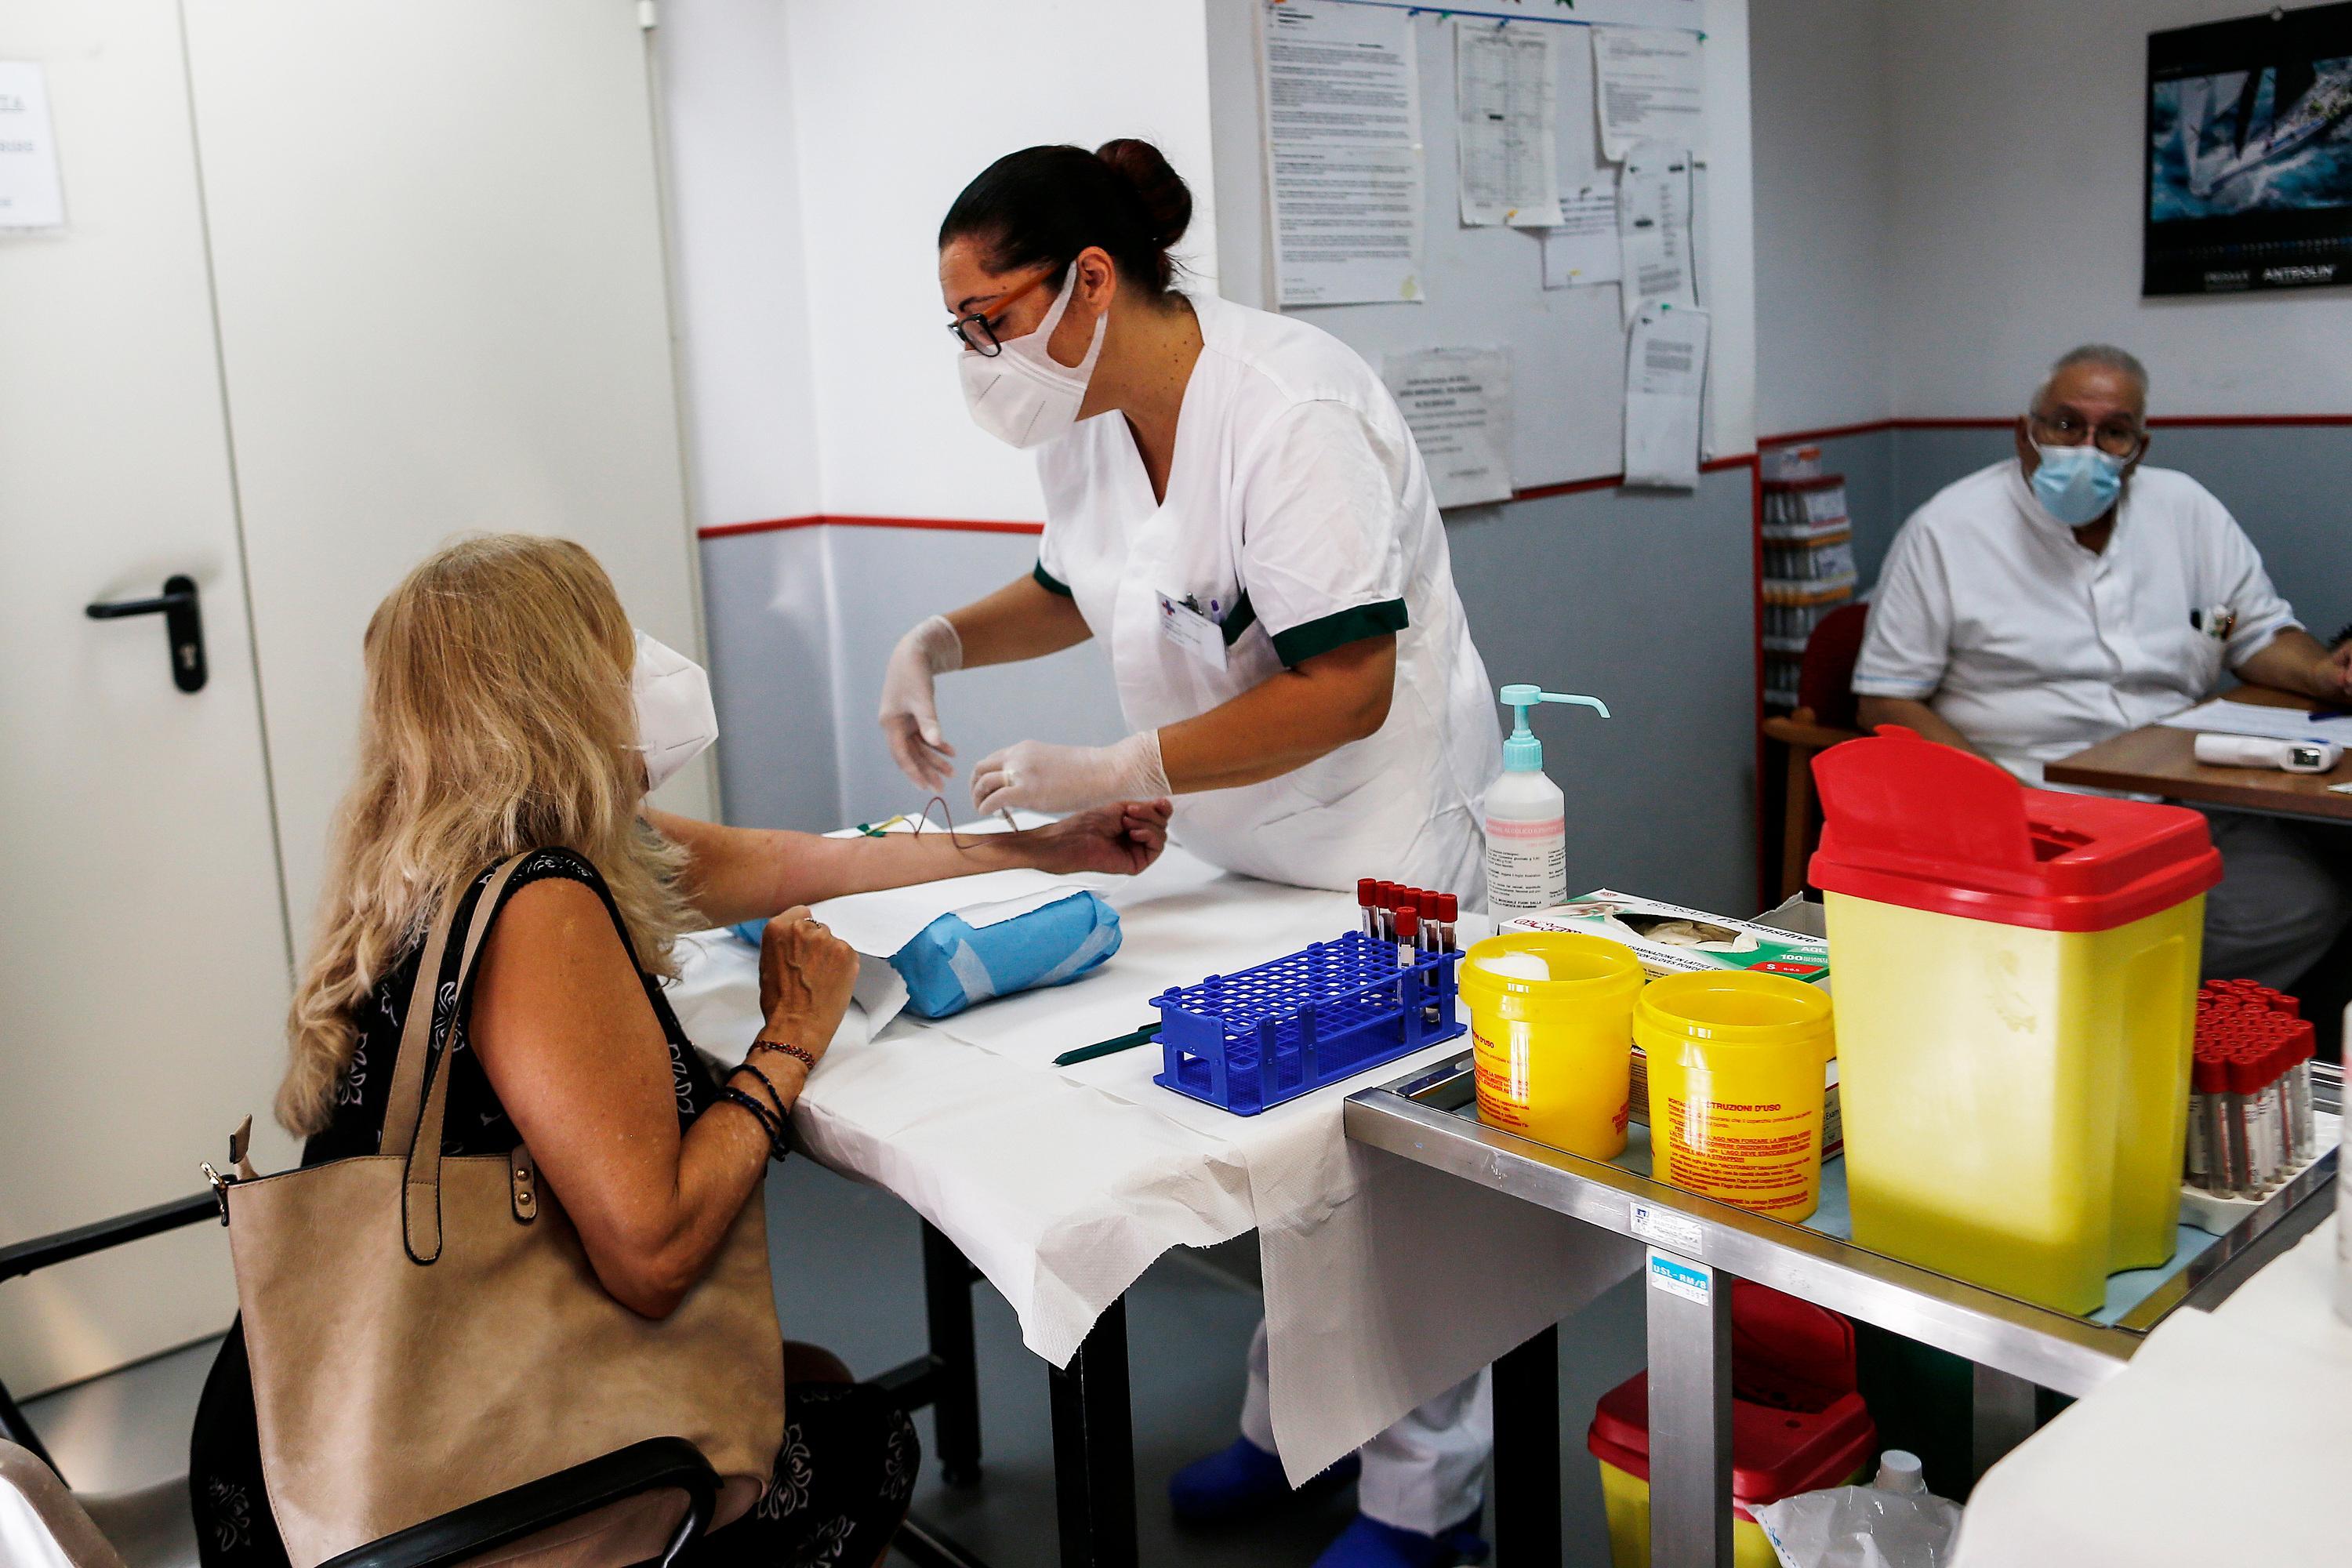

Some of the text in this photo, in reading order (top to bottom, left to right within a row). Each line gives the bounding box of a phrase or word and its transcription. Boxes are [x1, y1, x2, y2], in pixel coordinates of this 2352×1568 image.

[1741, 923, 1818, 944] Sensitive
[1650, 956, 1676, 965] GLOVES
[1684, 958, 1712, 969] LATTICE
[1705, 1100, 1781, 1112] STRUZIONI D'USO
